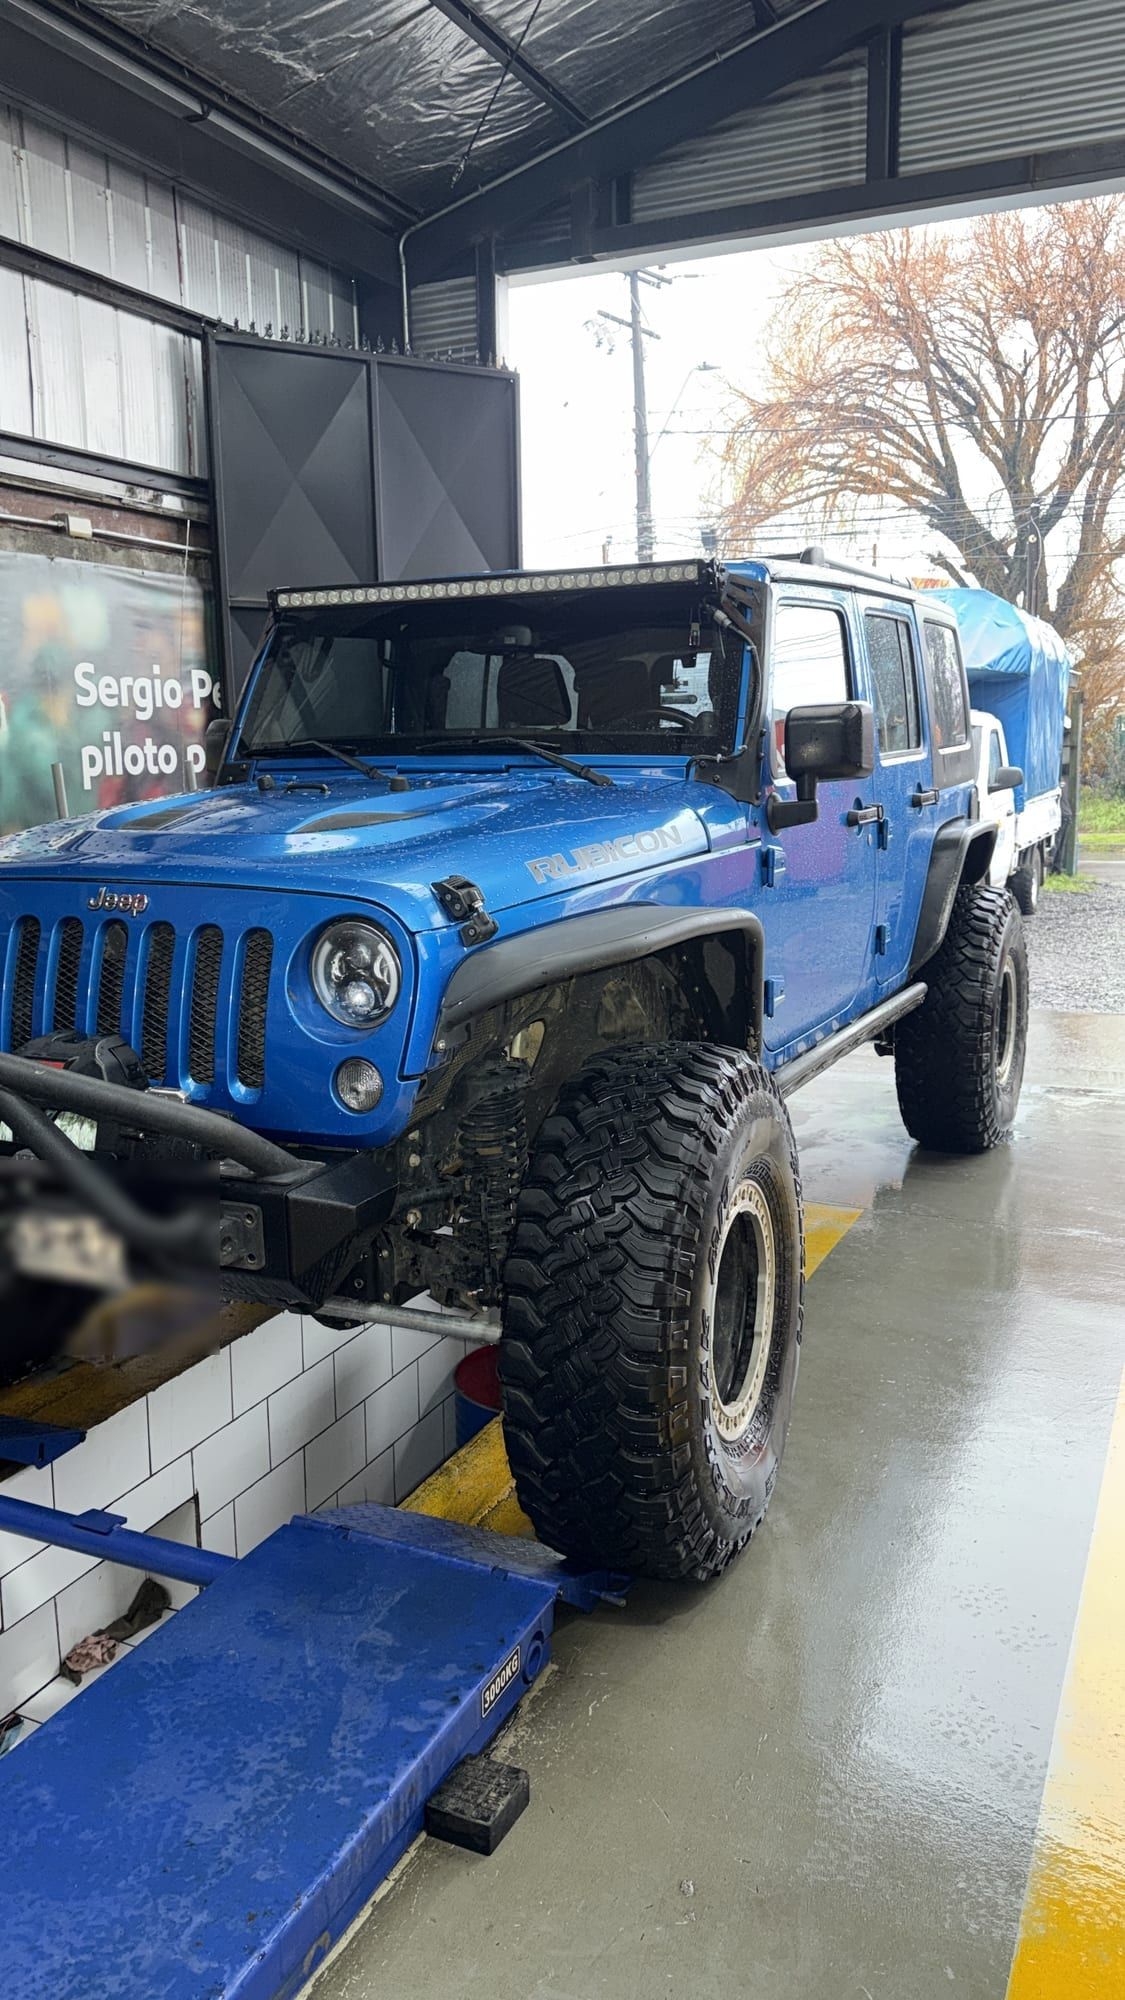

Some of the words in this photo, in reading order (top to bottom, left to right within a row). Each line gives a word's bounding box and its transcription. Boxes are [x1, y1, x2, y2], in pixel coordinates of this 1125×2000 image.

[74, 662, 183, 720] Sergio
[81, 731, 177, 790] piloto
[525, 825, 682, 885] RUBICON
[88, 887, 148, 917] Jeep
[484, 1654, 518, 1709] 3000KG
